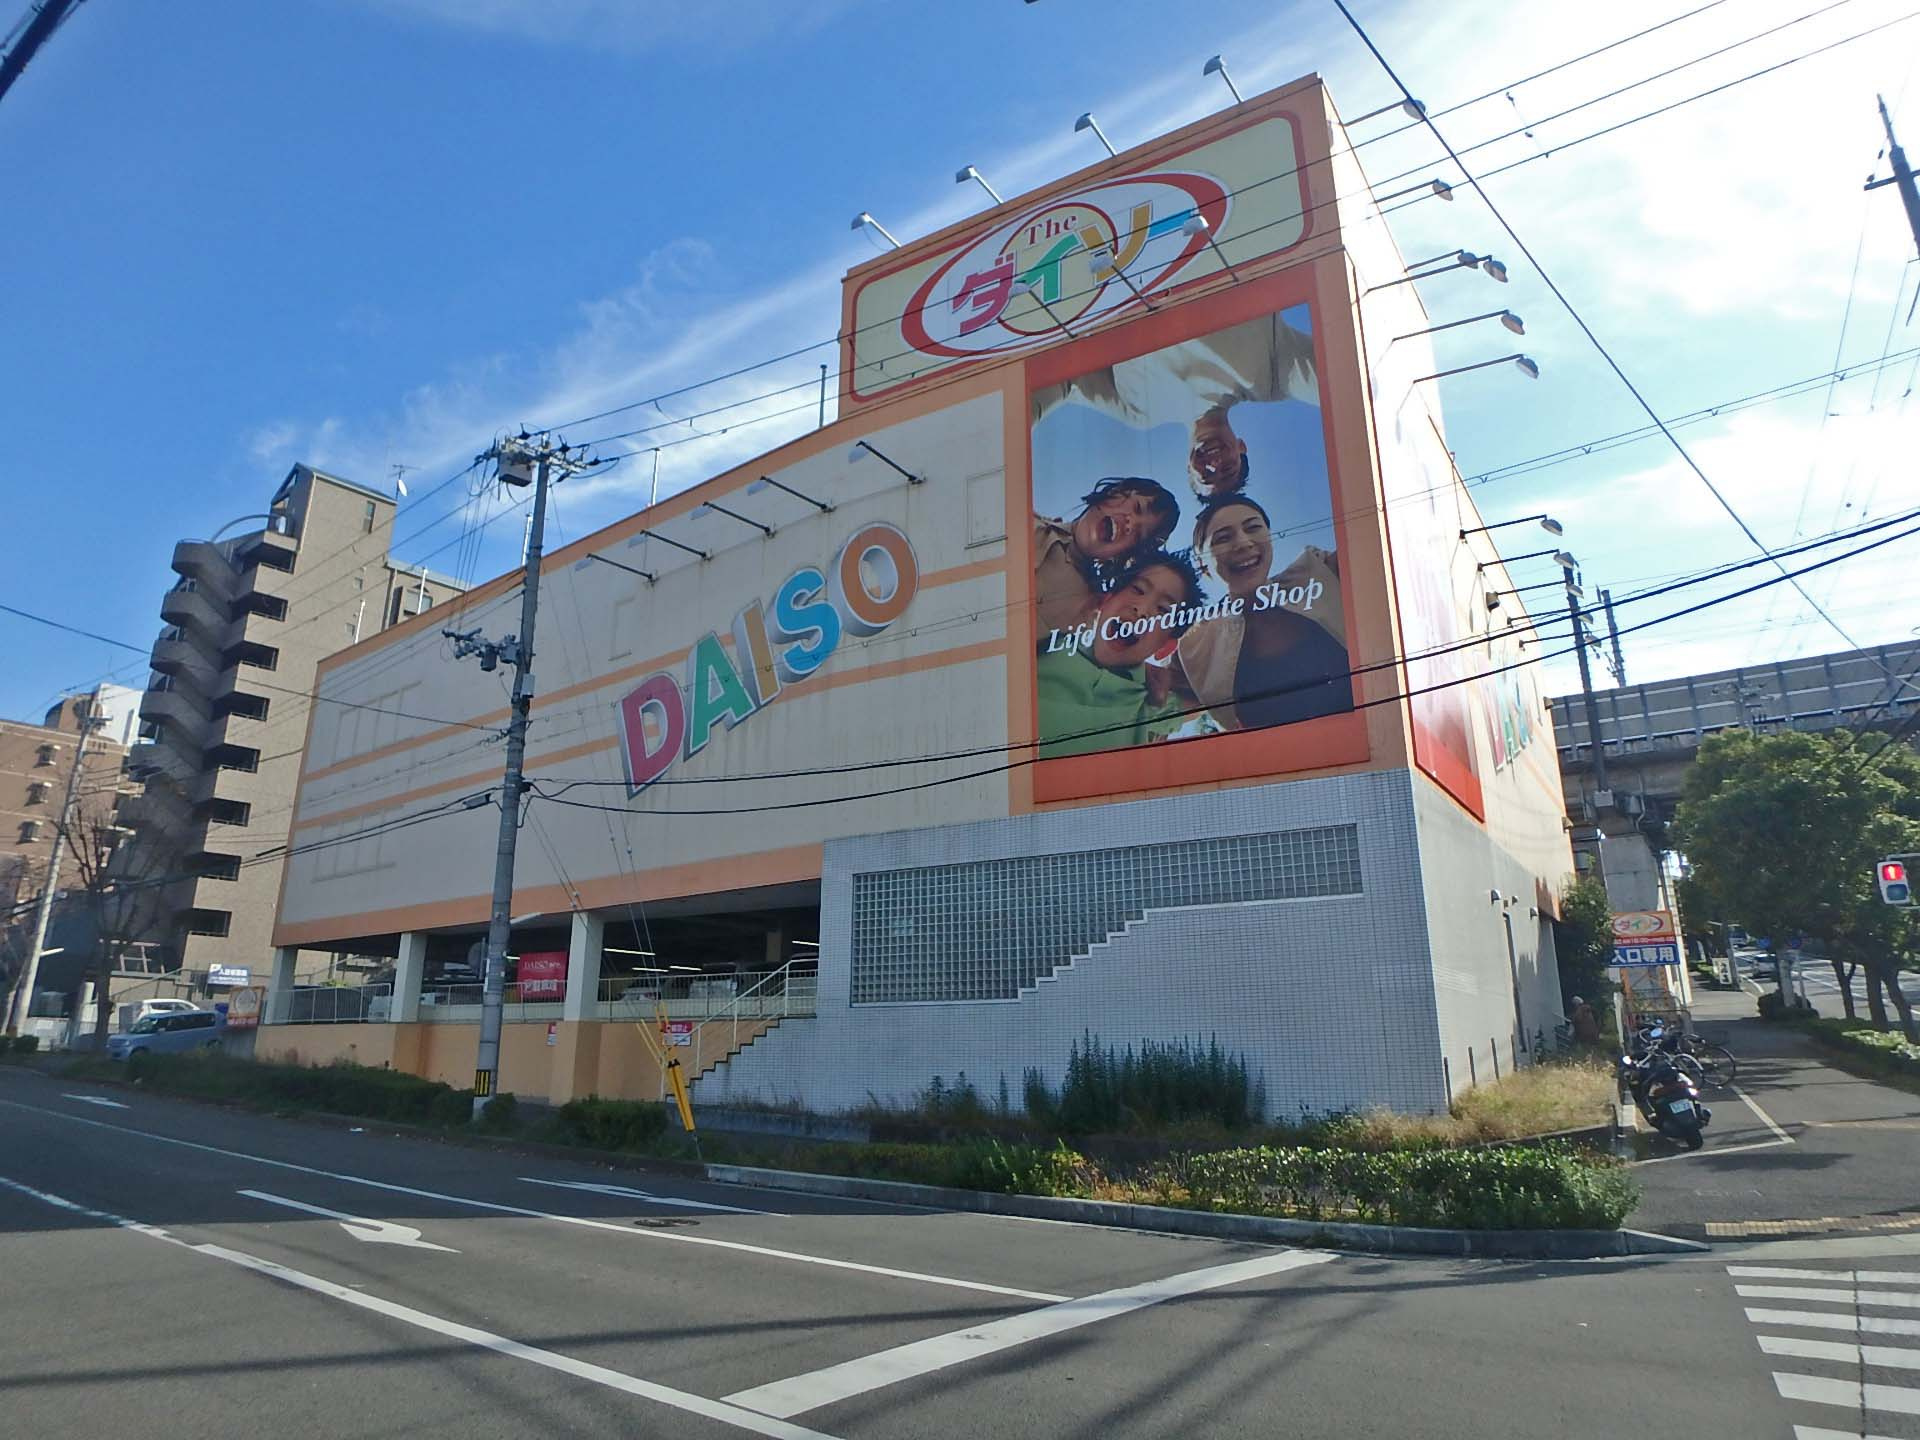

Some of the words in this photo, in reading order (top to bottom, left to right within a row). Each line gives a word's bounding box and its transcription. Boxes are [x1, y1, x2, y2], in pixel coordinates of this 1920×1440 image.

[951, 200, 1198, 337] ダイソー
[1025, 214, 1077, 246] The
[616, 521, 919, 800] DAISO
[1047, 622, 1096, 657] Life
[1101, 597, 1245, 641] Coordinate
[1252, 578, 1323, 611] Shop
